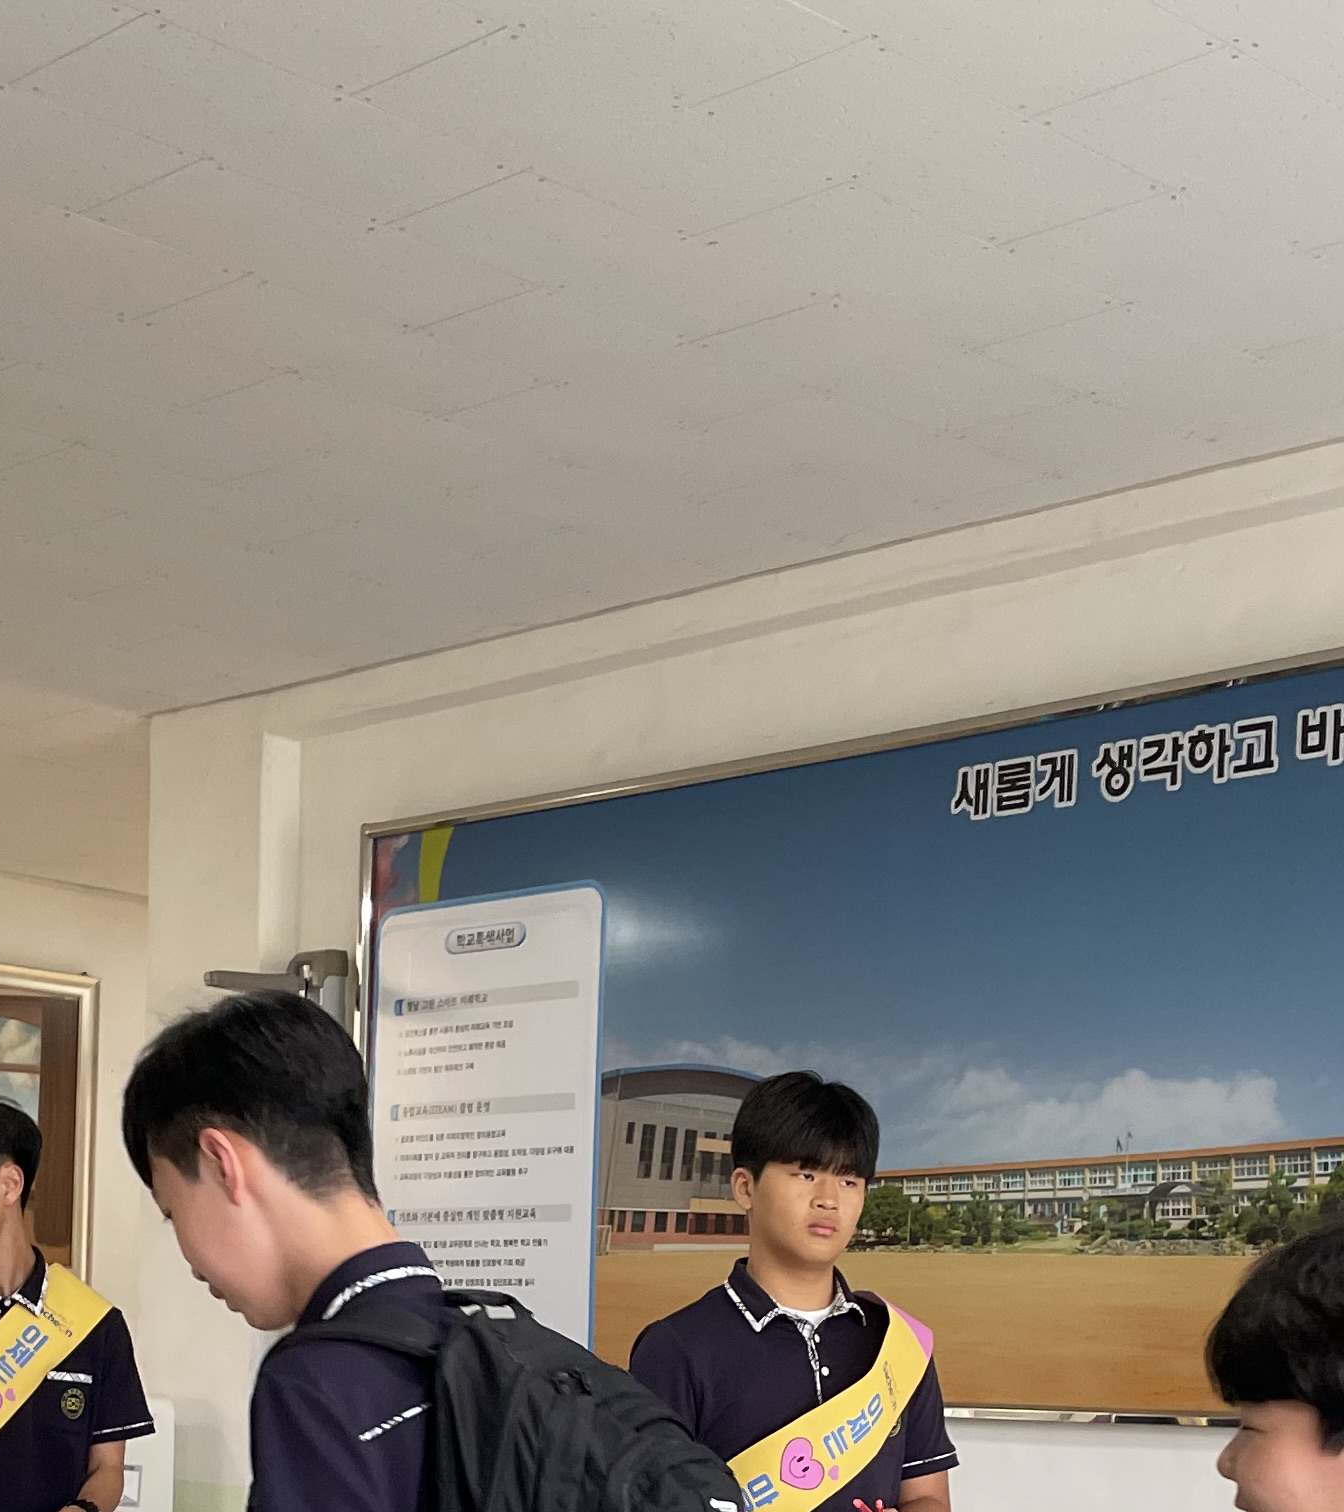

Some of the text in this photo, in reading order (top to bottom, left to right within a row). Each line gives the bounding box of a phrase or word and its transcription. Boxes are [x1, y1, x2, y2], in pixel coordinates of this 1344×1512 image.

[952, 750, 1077, 819] 새롭게
[1092, 716, 1277, 802] 생각하고
[822, 1393, 883, 1459] 이제는
